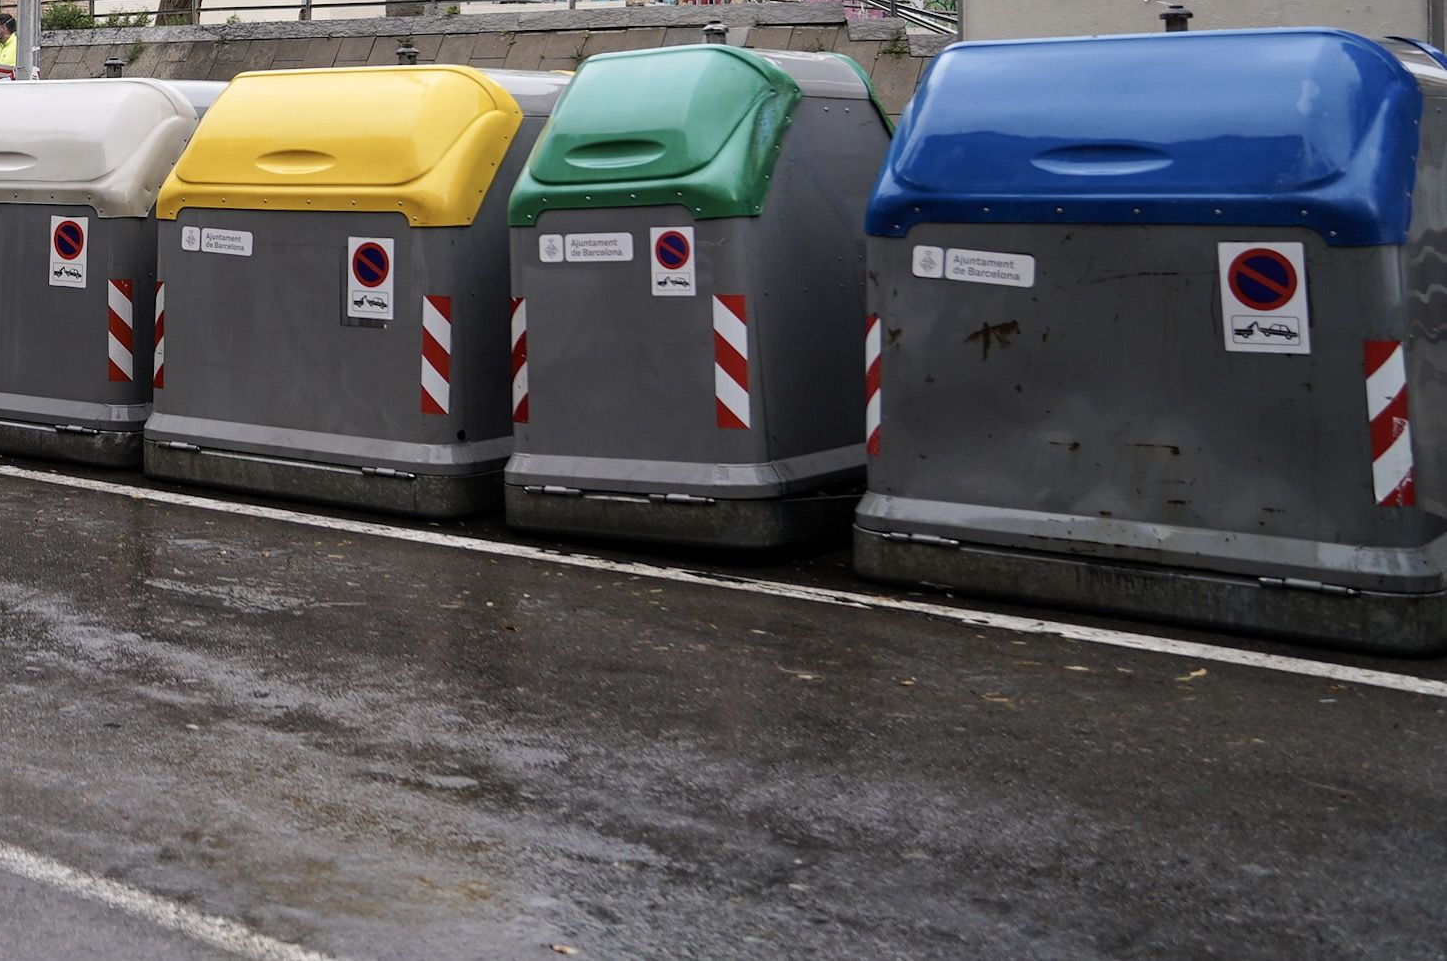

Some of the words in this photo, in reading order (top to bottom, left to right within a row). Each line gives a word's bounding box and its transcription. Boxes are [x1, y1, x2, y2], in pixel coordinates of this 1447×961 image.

[206, 232, 242, 243] Ajuntament
[214, 241, 245, 251] Barcelona
[571, 238, 618, 248] Ajuntament
[583, 248, 623, 256] Barcelona
[953, 255, 1015, 270] Ajuntament
[953, 266, 966, 275] de
[968, 267, 1021, 281] Barcelona
